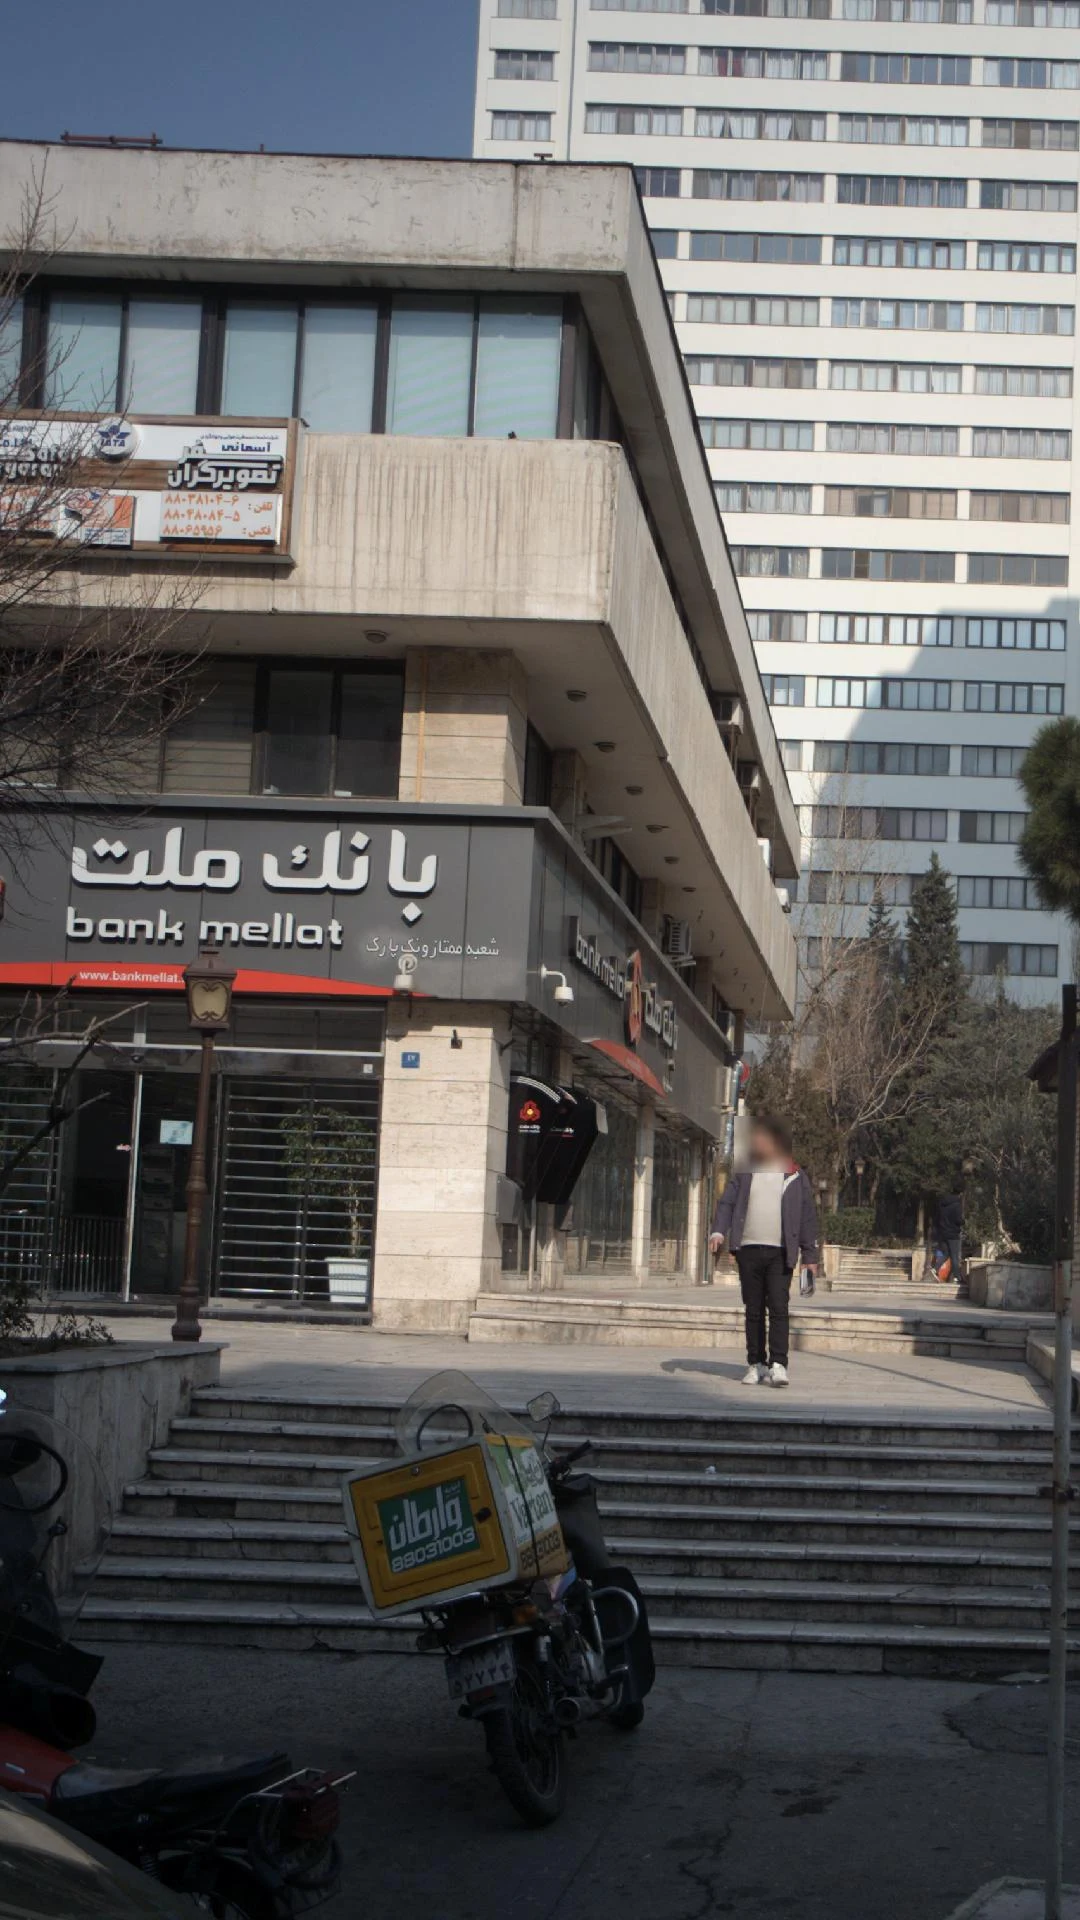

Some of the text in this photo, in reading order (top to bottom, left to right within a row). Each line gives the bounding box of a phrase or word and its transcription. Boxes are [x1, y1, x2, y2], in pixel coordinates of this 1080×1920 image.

[71, 826, 241, 889] ملت
[66, 906, 343, 948] bank mellat
[79, 970, 186, 983] www.bankmellat.
